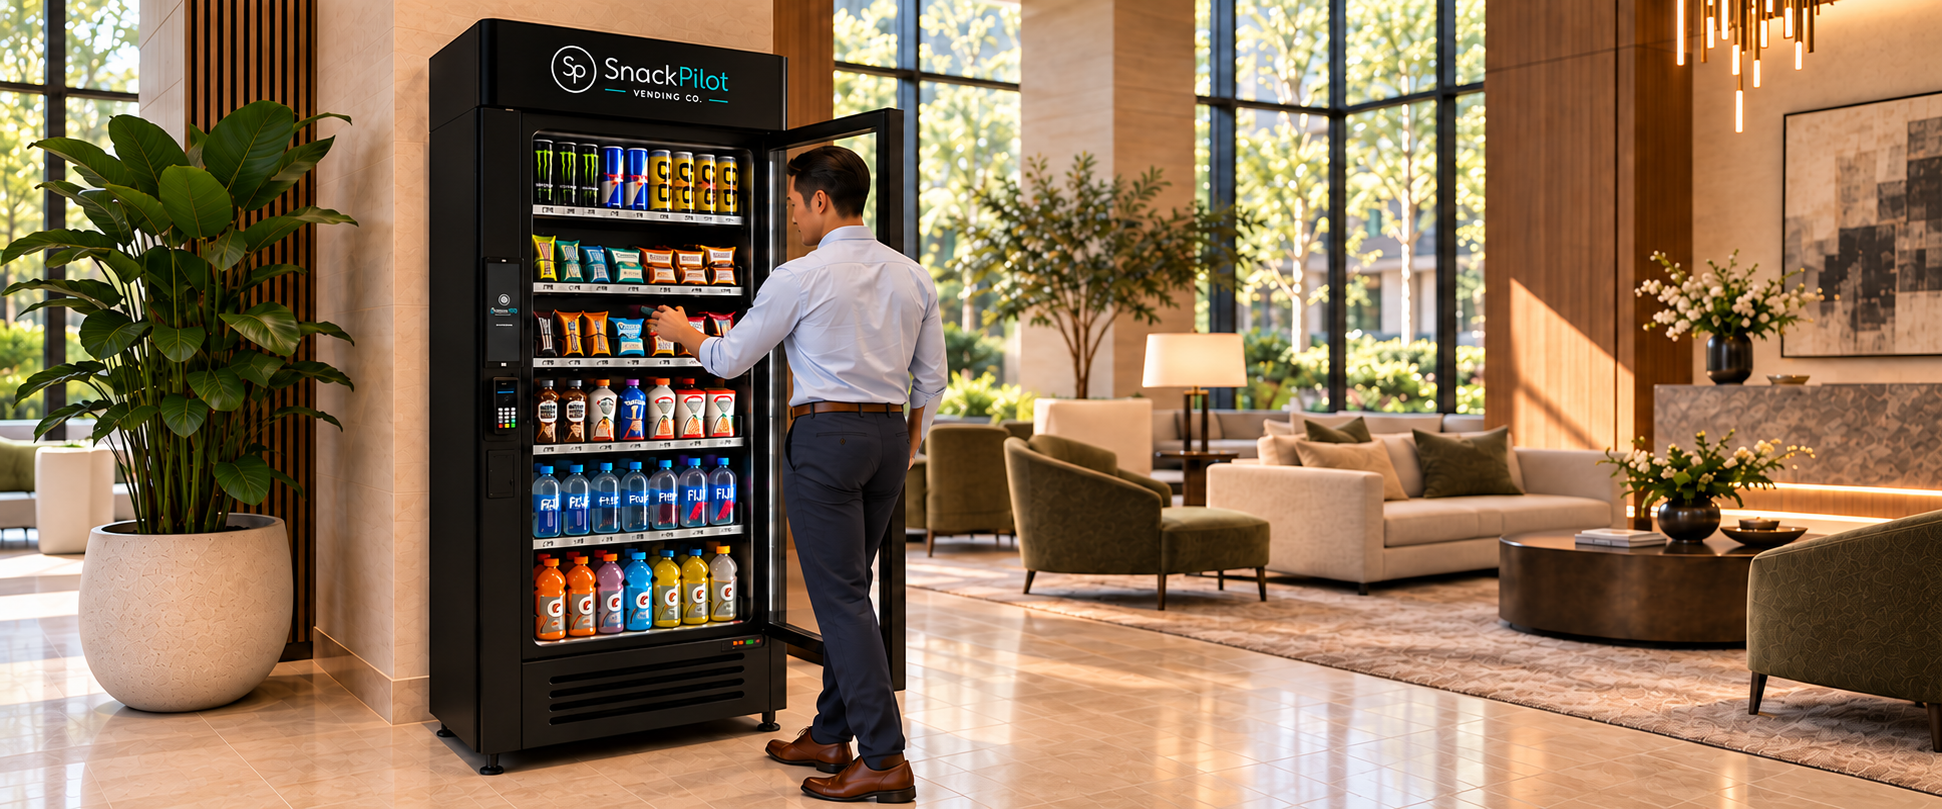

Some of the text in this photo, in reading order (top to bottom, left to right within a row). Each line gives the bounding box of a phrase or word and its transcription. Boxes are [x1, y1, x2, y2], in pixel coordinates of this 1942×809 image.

[604, 57, 729, 92] SnackPilot
[633, 89, 702, 103] VENDING CO.
